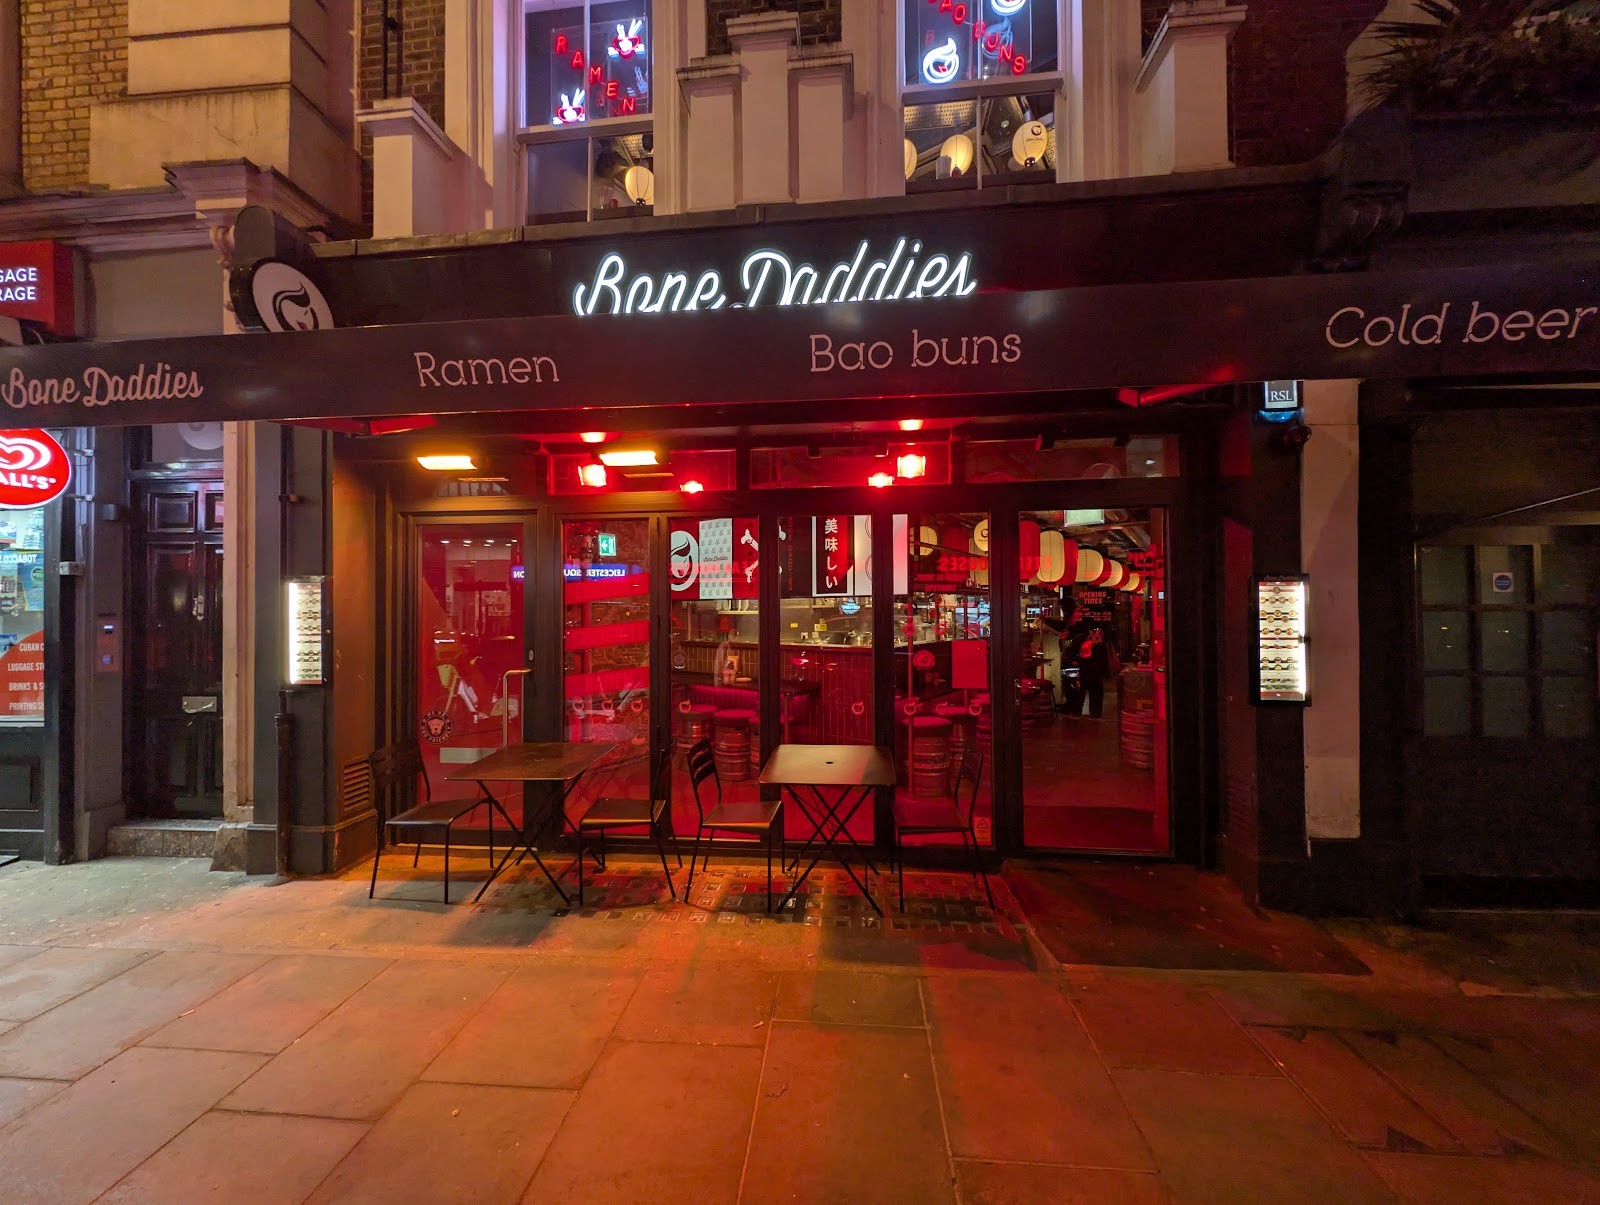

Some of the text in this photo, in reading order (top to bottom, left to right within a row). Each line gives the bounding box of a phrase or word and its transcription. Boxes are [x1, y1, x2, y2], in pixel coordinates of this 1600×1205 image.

[927, 0, 967, 25] AO
[973, 20, 1028, 76] BUNS
[556, 34, 636, 117] RAMEN
[573, 237, 977, 315] Bone Daddies
[1326, 300, 1598, 348] Cold beer
[414, 351, 560, 387] Ramen
[810, 329, 1021, 372] Bao buns
[1, 362, 204, 408] Bone Daddies
[1270, 390, 1292, 401] RSL
[824, 518, 839, 589] 美味しい
[7, 662, 34, 671] LUGGAGE
[19, 643, 40, 652] CUBAN
[8, 682, 31, 691] DRINKS
[9, 702, 38, 711] PRINTING
